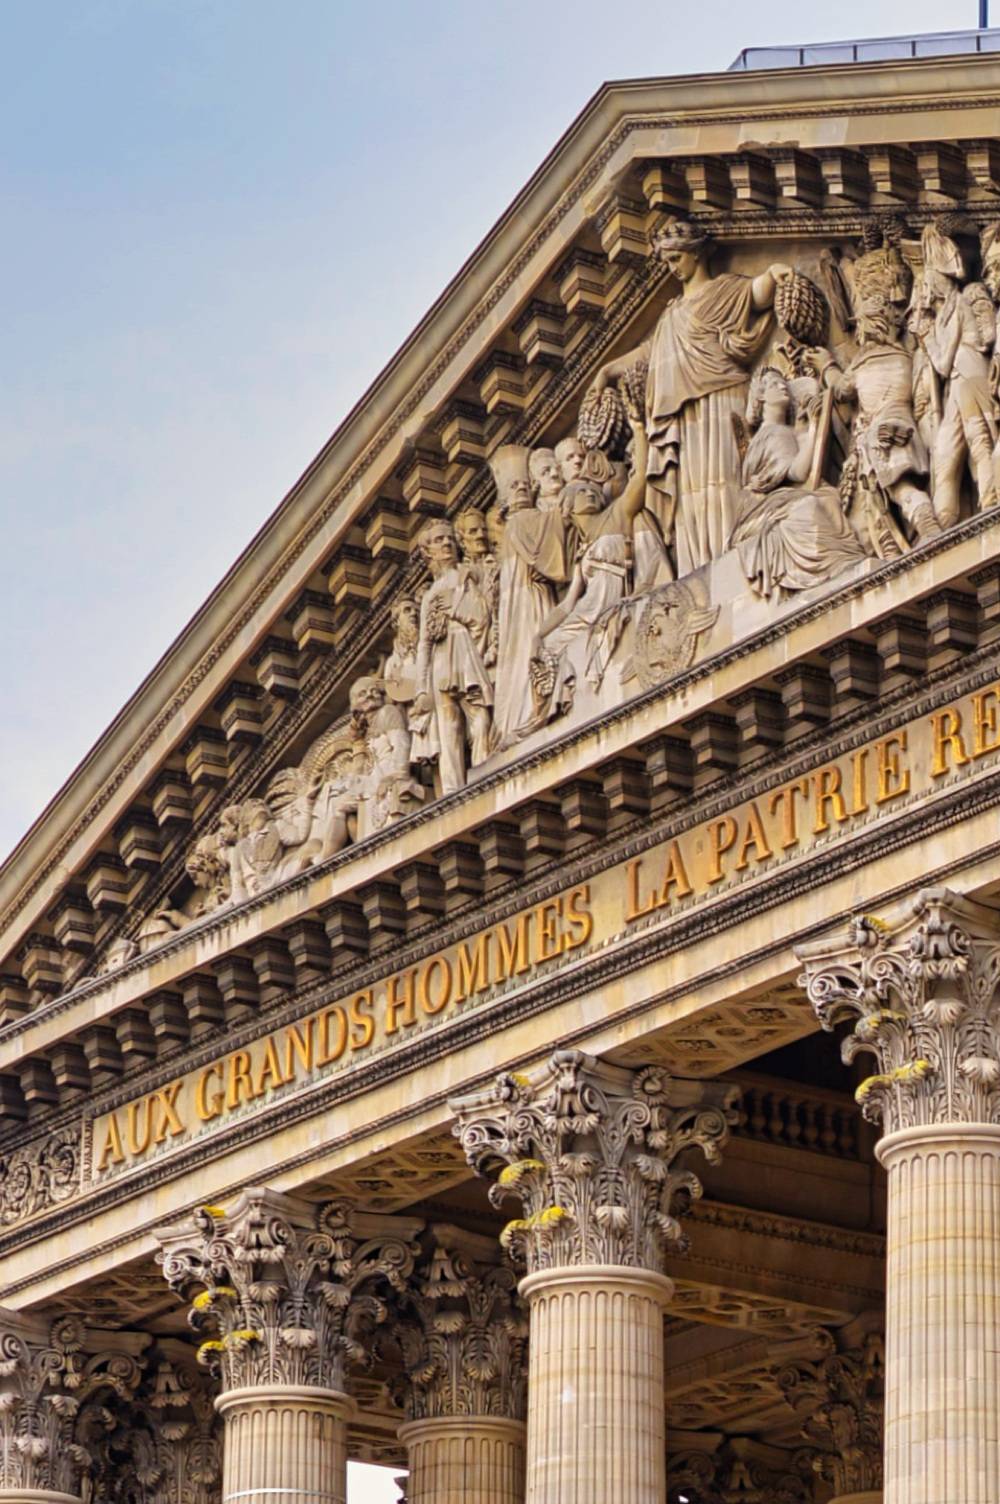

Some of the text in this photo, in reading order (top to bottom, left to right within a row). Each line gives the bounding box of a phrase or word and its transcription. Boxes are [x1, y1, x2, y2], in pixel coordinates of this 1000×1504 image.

[97, 1084, 186, 1173] AUX
[195, 993, 375, 1121] GRANDS
[383, 884, 595, 1036] HOMMES
[625, 850, 695, 923] LA
[703, 728, 911, 884] PATRIE
